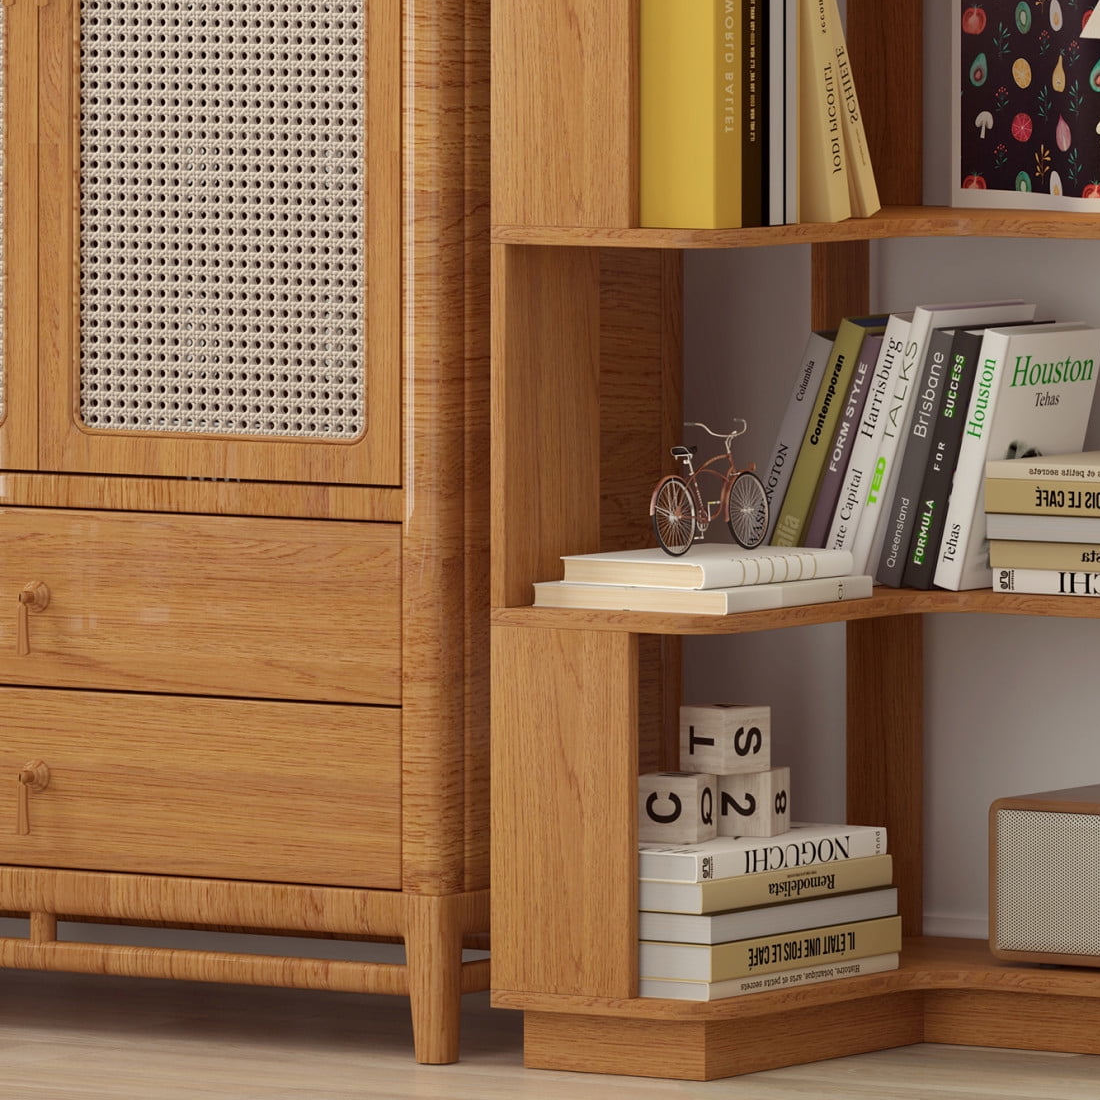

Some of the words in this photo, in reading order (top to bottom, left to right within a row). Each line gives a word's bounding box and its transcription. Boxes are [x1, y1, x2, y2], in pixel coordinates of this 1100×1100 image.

[1009, 355, 1094, 387] Houston
[810, 354, 845, 445] Contemporan
[1035, 391, 1061, 407] Tehas
[829, 422, 850, 473] FORM
[846, 362, 868, 418] STYLE
[840, 469, 863, 521] Capital
[861, 337, 903, 439] Harrisburg
[866, 456, 887, 506] TED
[883, 341, 919, 439] TALKS
[747, 443, 789, 546] WASHNGTON
[796, 360, 815, 402] Columbia
[886, 497, 910, 568] Queensland
[913, 352, 945, 438] Brisbane
[913, 499, 936, 565] FORMULA
[933, 442, 946, 471] FOR
[944, 354, 965, 418] SUCCESS
[942, 523, 961, 562] Tehas
[966, 358, 997, 439] Houston
[689, 725, 715, 755] T
[734, 726, 762, 757] S
[646, 791, 682, 824] C
[701, 787, 713, 826] Q
[721, 791, 756, 816] 2
[775, 790, 787, 815] 8
[744, 836, 850, 874] NOGUCHI
[768, 874, 836, 897] Remodelista
[772, 943, 782, 964] LE
[784, 940, 802, 961] FOIS
[804, 937, 821, 958] UNE
[823, 933, 846, 956] ÉTAIT
[848, 932, 855, 950] IL
[748, 945, 770, 971] CAFÉ
